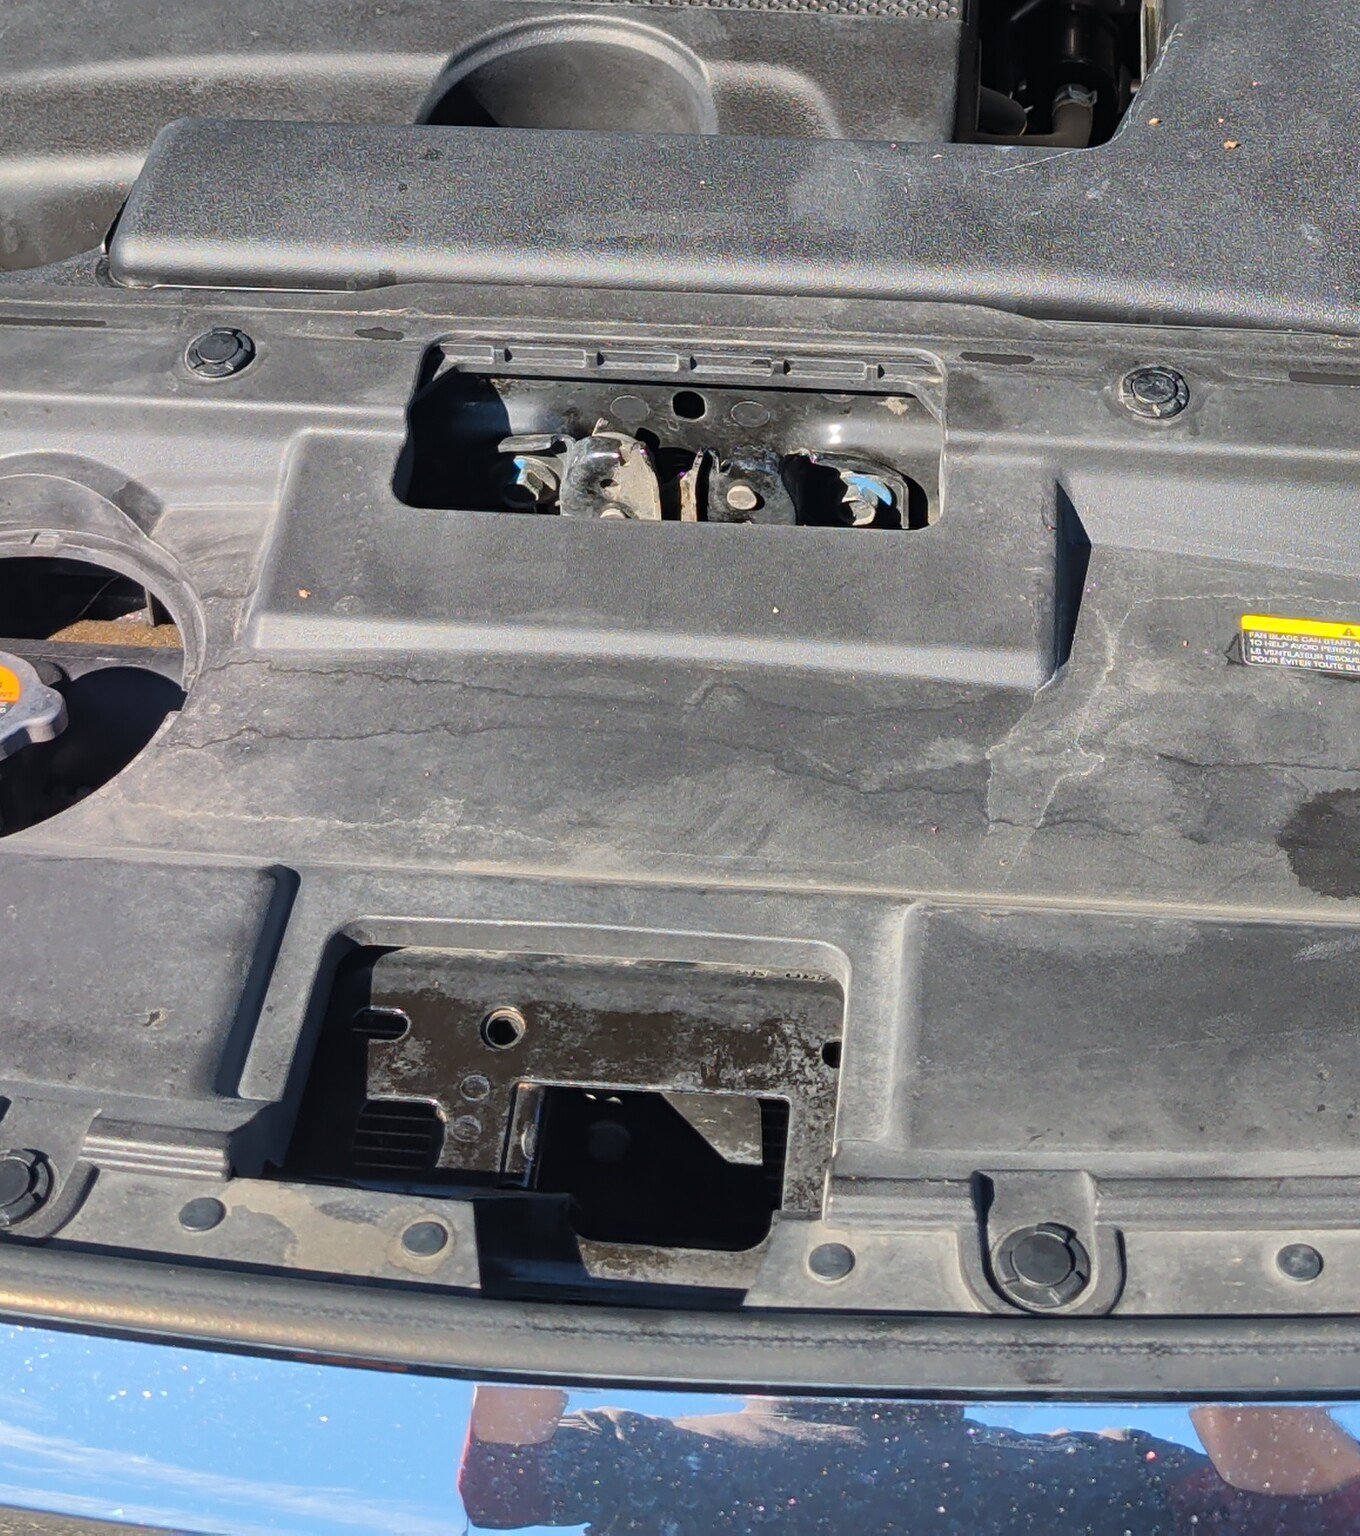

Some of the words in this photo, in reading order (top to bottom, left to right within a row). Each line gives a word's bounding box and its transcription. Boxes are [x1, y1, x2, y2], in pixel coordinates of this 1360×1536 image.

[1249, 631, 1267, 640] FAN
[1269, 633, 1299, 643] BLADE
[1301, 636, 1321, 644] CAN
[1323, 638, 1351, 647] START
[1265, 640, 1289, 649] HELP
[1290, 642, 1319, 651] AVOID
[1250, 647, 1261, 655] LE
[1263, 648, 1324, 661] VENTILATEUR
[1325, 652, 1360, 664] RISQUE
[1251, 655, 1279, 664] POUR
[1281, 657, 1313, 668] ÉVITER
[1313, 661, 1344, 671] TOUTE
